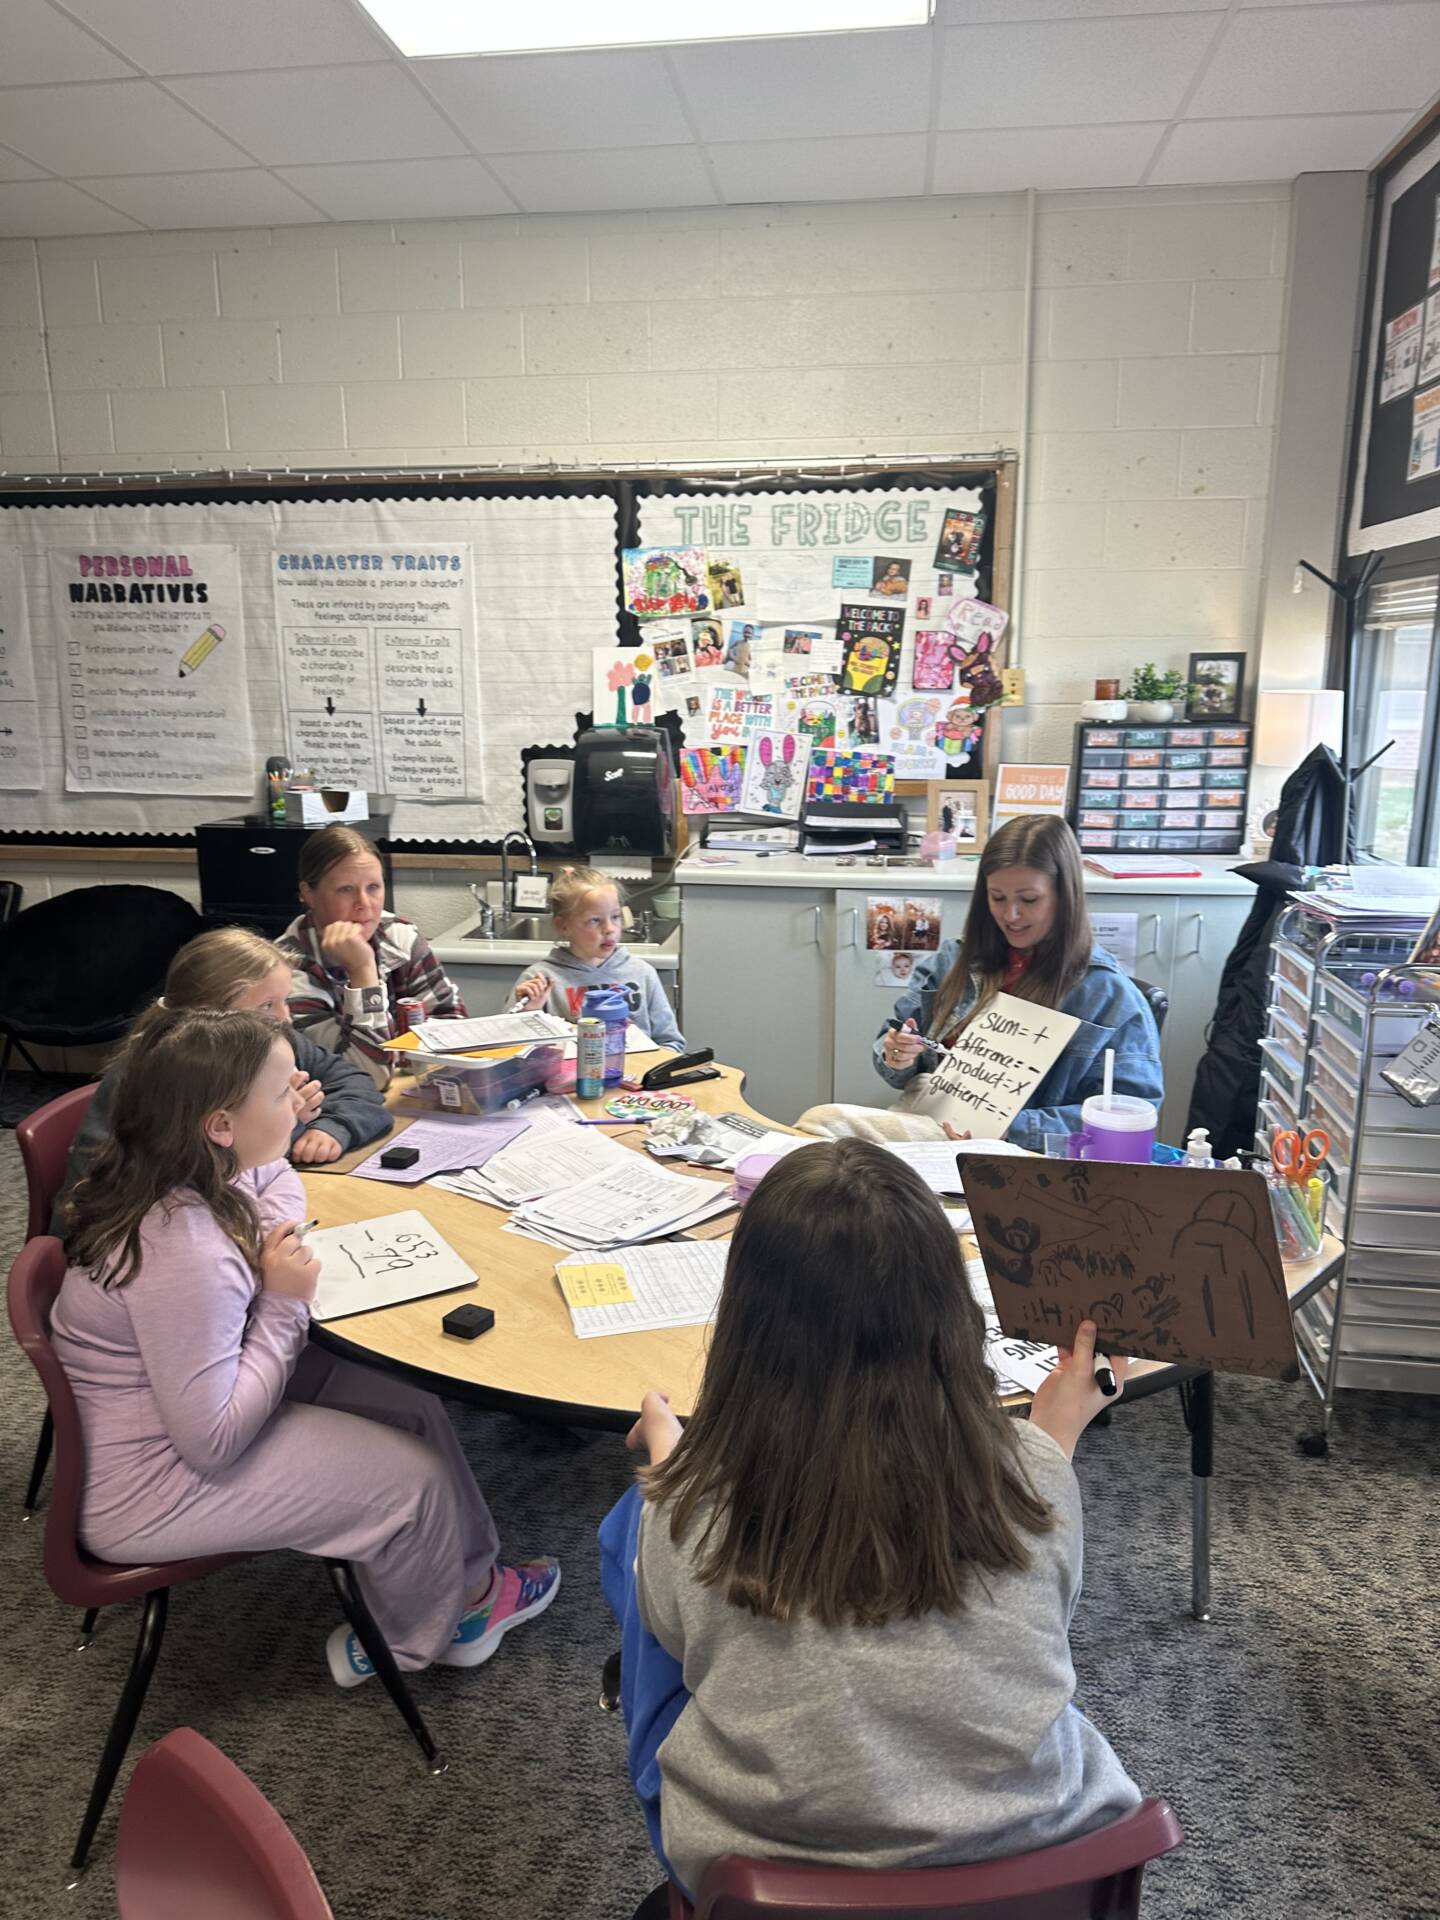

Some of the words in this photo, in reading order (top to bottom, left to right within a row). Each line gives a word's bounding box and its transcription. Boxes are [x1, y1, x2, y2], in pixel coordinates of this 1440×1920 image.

[673, 503, 751, 546] THE
[771, 500, 930, 546] FRIDGE
[79, 555, 194, 578] PERSONAL
[278, 554, 383, 571] CHARACTER
[391, 555, 462, 571] TRAITS
[69, 583, 209, 604] NARRATIVES
[843, 607, 886, 621] WELCOME
[888, 610, 900, 621] TO
[1006, 784, 1036, 801] GOOD
[1040, 784, 1065, 801] DAY
[616, 1096, 650, 1109] DAY
[651, 1099, 691, 1111] GOOD
